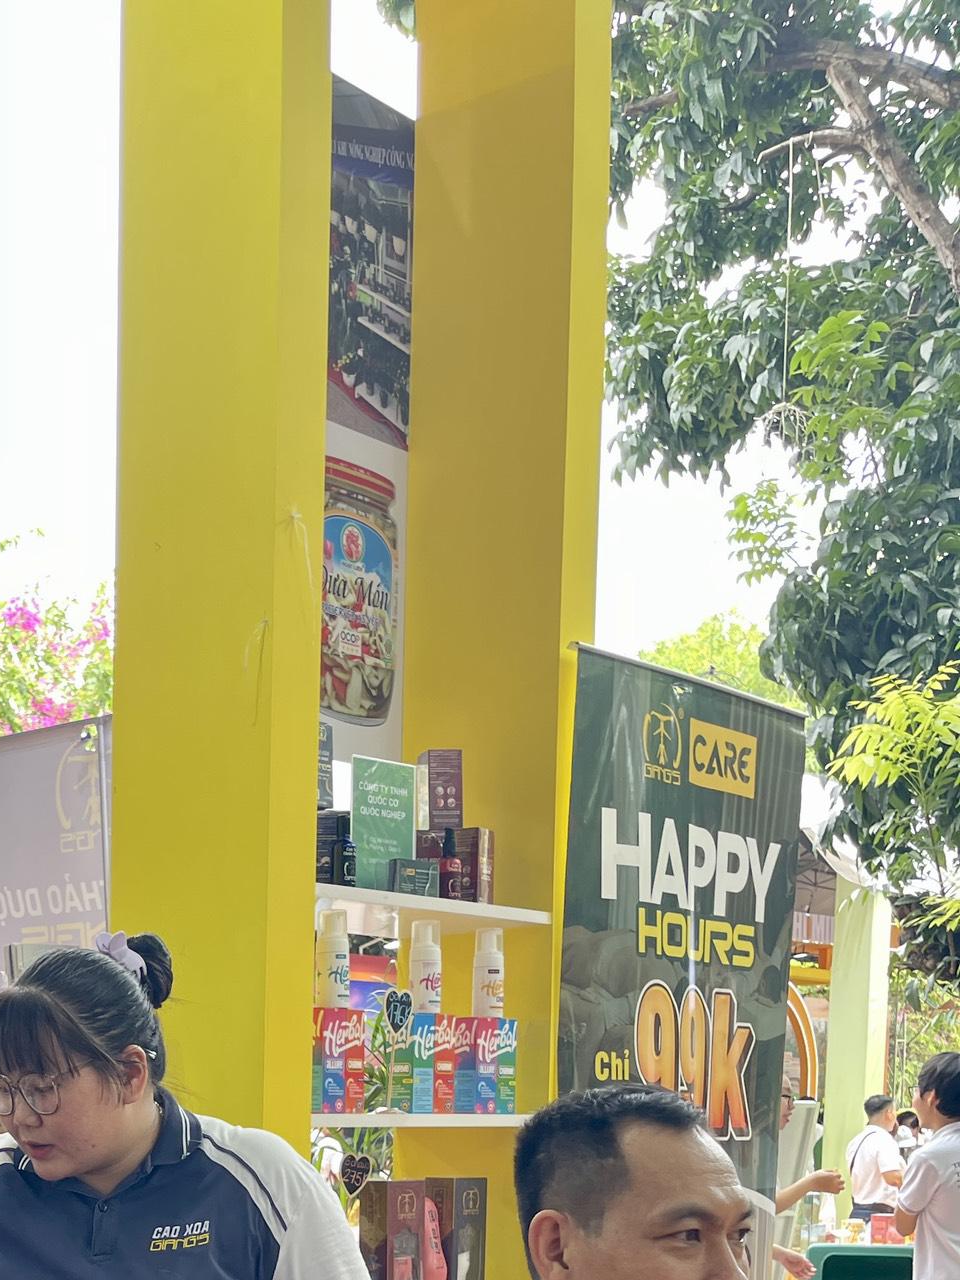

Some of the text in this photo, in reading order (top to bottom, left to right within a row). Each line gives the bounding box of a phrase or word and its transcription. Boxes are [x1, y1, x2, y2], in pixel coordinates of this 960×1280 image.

[692, 733, 752, 785] CARE
[600, 807, 782, 924] HAPPY
[638, 907, 755, 969] HOURS
[323, 1012, 366, 1057] Herbal
[476, 1019, 517, 1063] Herbal
[594, 1048, 630, 1082] Chỉ
[152, 1220, 210, 1239] CAO XOA
